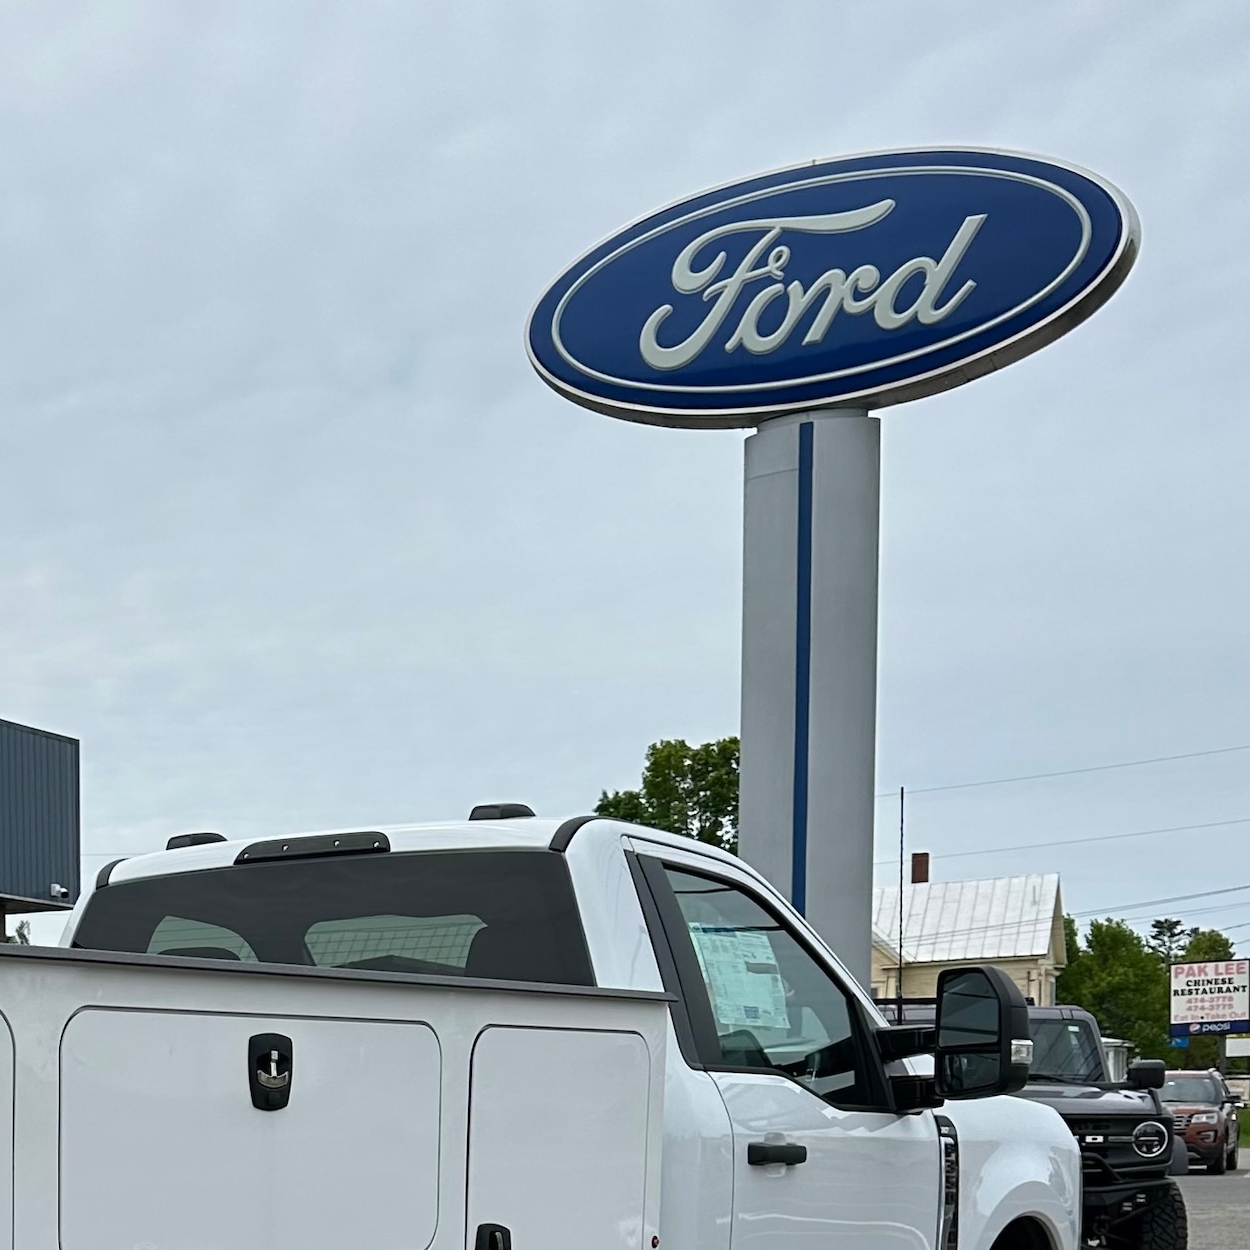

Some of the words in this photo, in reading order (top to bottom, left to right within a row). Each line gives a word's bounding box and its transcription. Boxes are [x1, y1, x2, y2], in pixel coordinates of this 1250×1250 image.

[639, 198, 989, 371] Ford
[1174, 965, 1208, 979] PAK
[1214, 962, 1246, 976] LEE
[1186, 977, 1234, 987] CHINESE
[1173, 985, 1247, 997] RESTAURANT
[1205, 1012, 1227, 1020] Take
[1230, 1011, 1246, 1019] Out
[1202, 1022, 1230, 1032] pepsi
